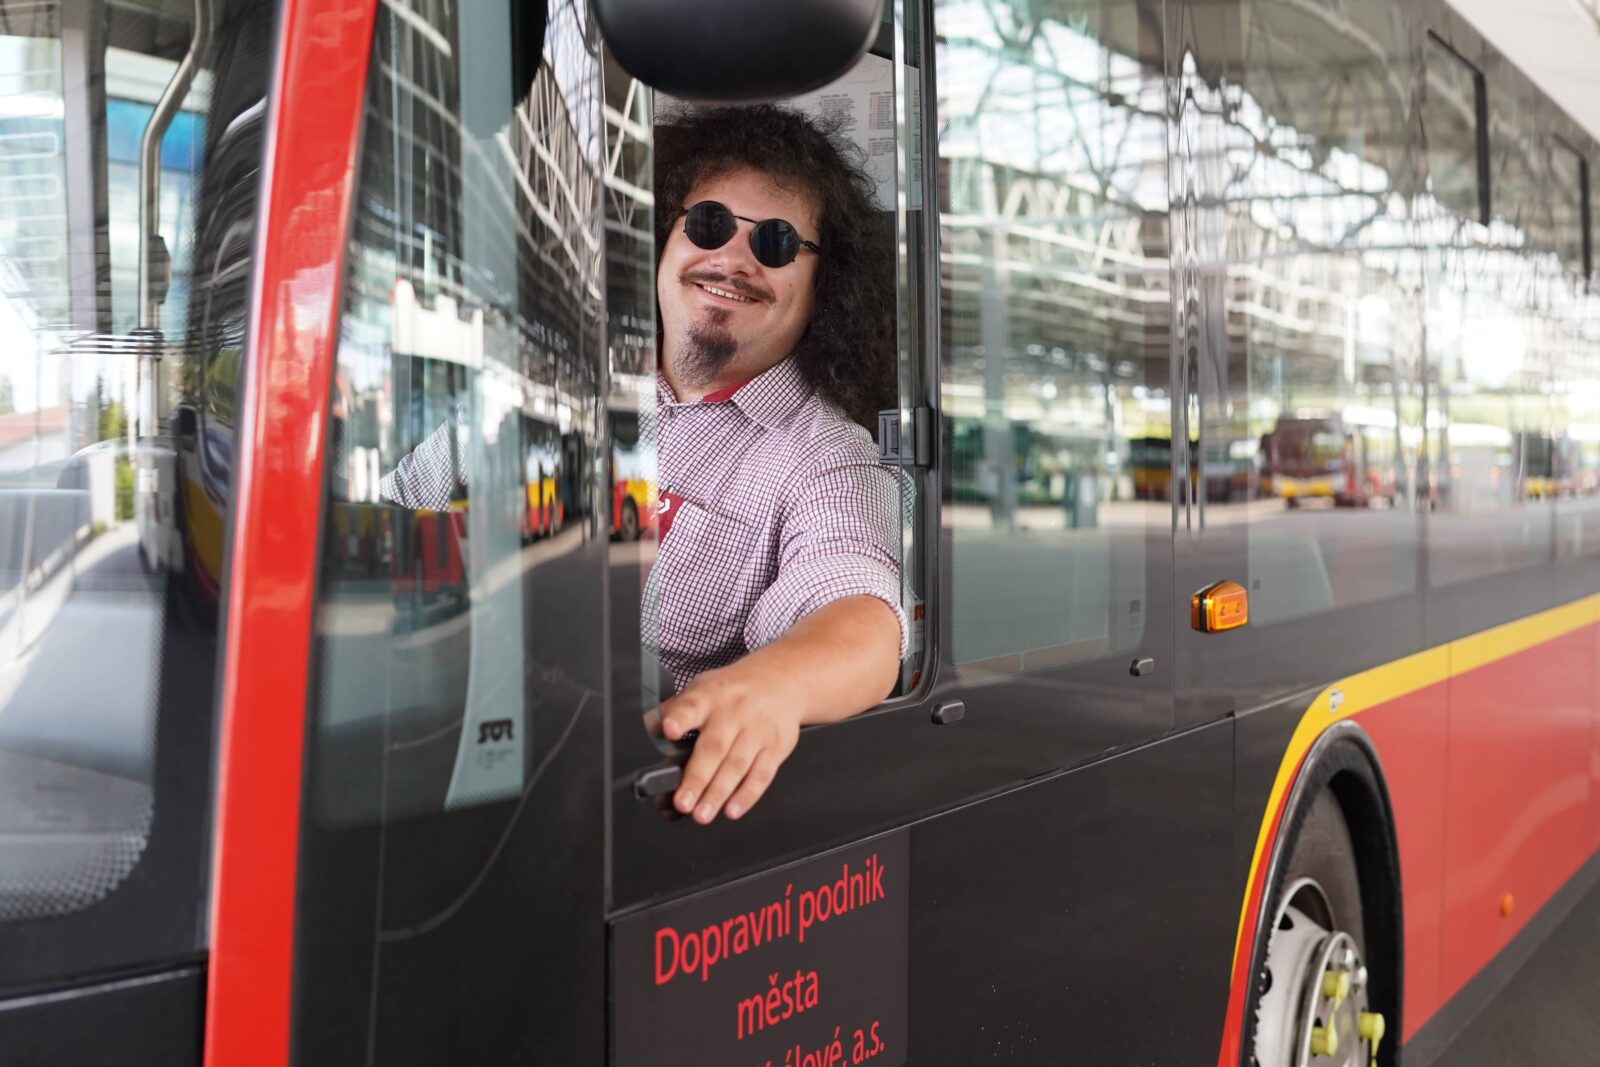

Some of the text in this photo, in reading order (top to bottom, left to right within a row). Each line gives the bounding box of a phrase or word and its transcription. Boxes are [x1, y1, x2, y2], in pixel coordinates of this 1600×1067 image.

[655, 854, 885, 986] Dopravní podnik
[736, 970, 819, 1039] města
[852, 1020, 885, 1065] a.s.
